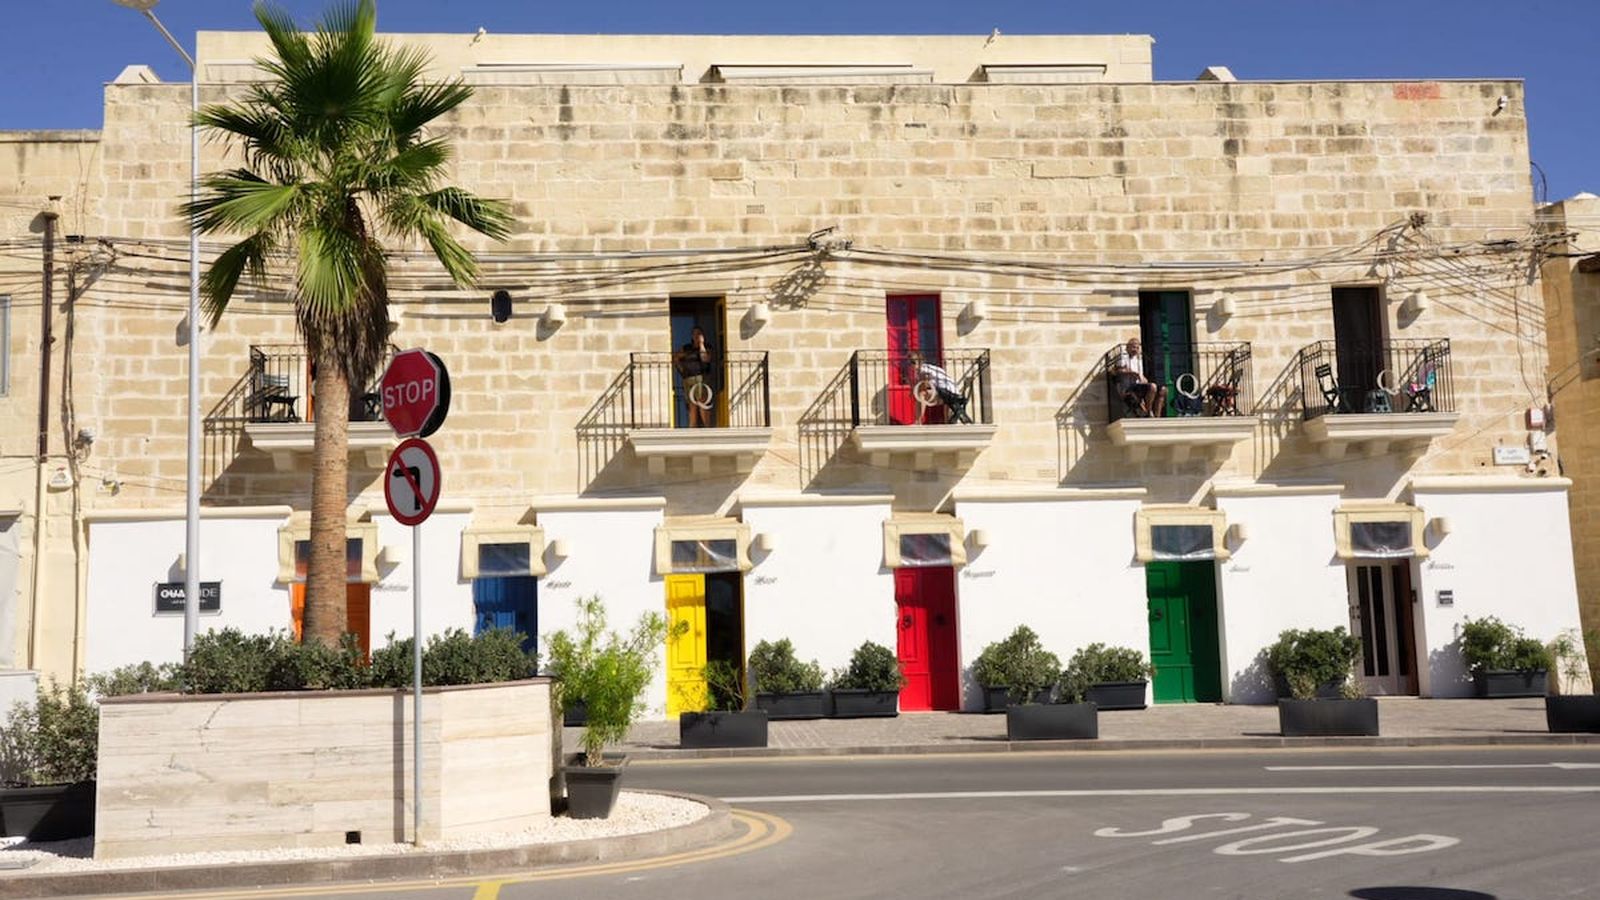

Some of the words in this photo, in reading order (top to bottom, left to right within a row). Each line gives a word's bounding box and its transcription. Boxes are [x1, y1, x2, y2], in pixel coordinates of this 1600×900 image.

[385, 378, 433, 408] STOP
[689, 382, 713, 409] Q
[914, 381, 938, 407] Q
[1176, 373, 1200, 399] Q
[1094, 812, 1461, 863] STOP
